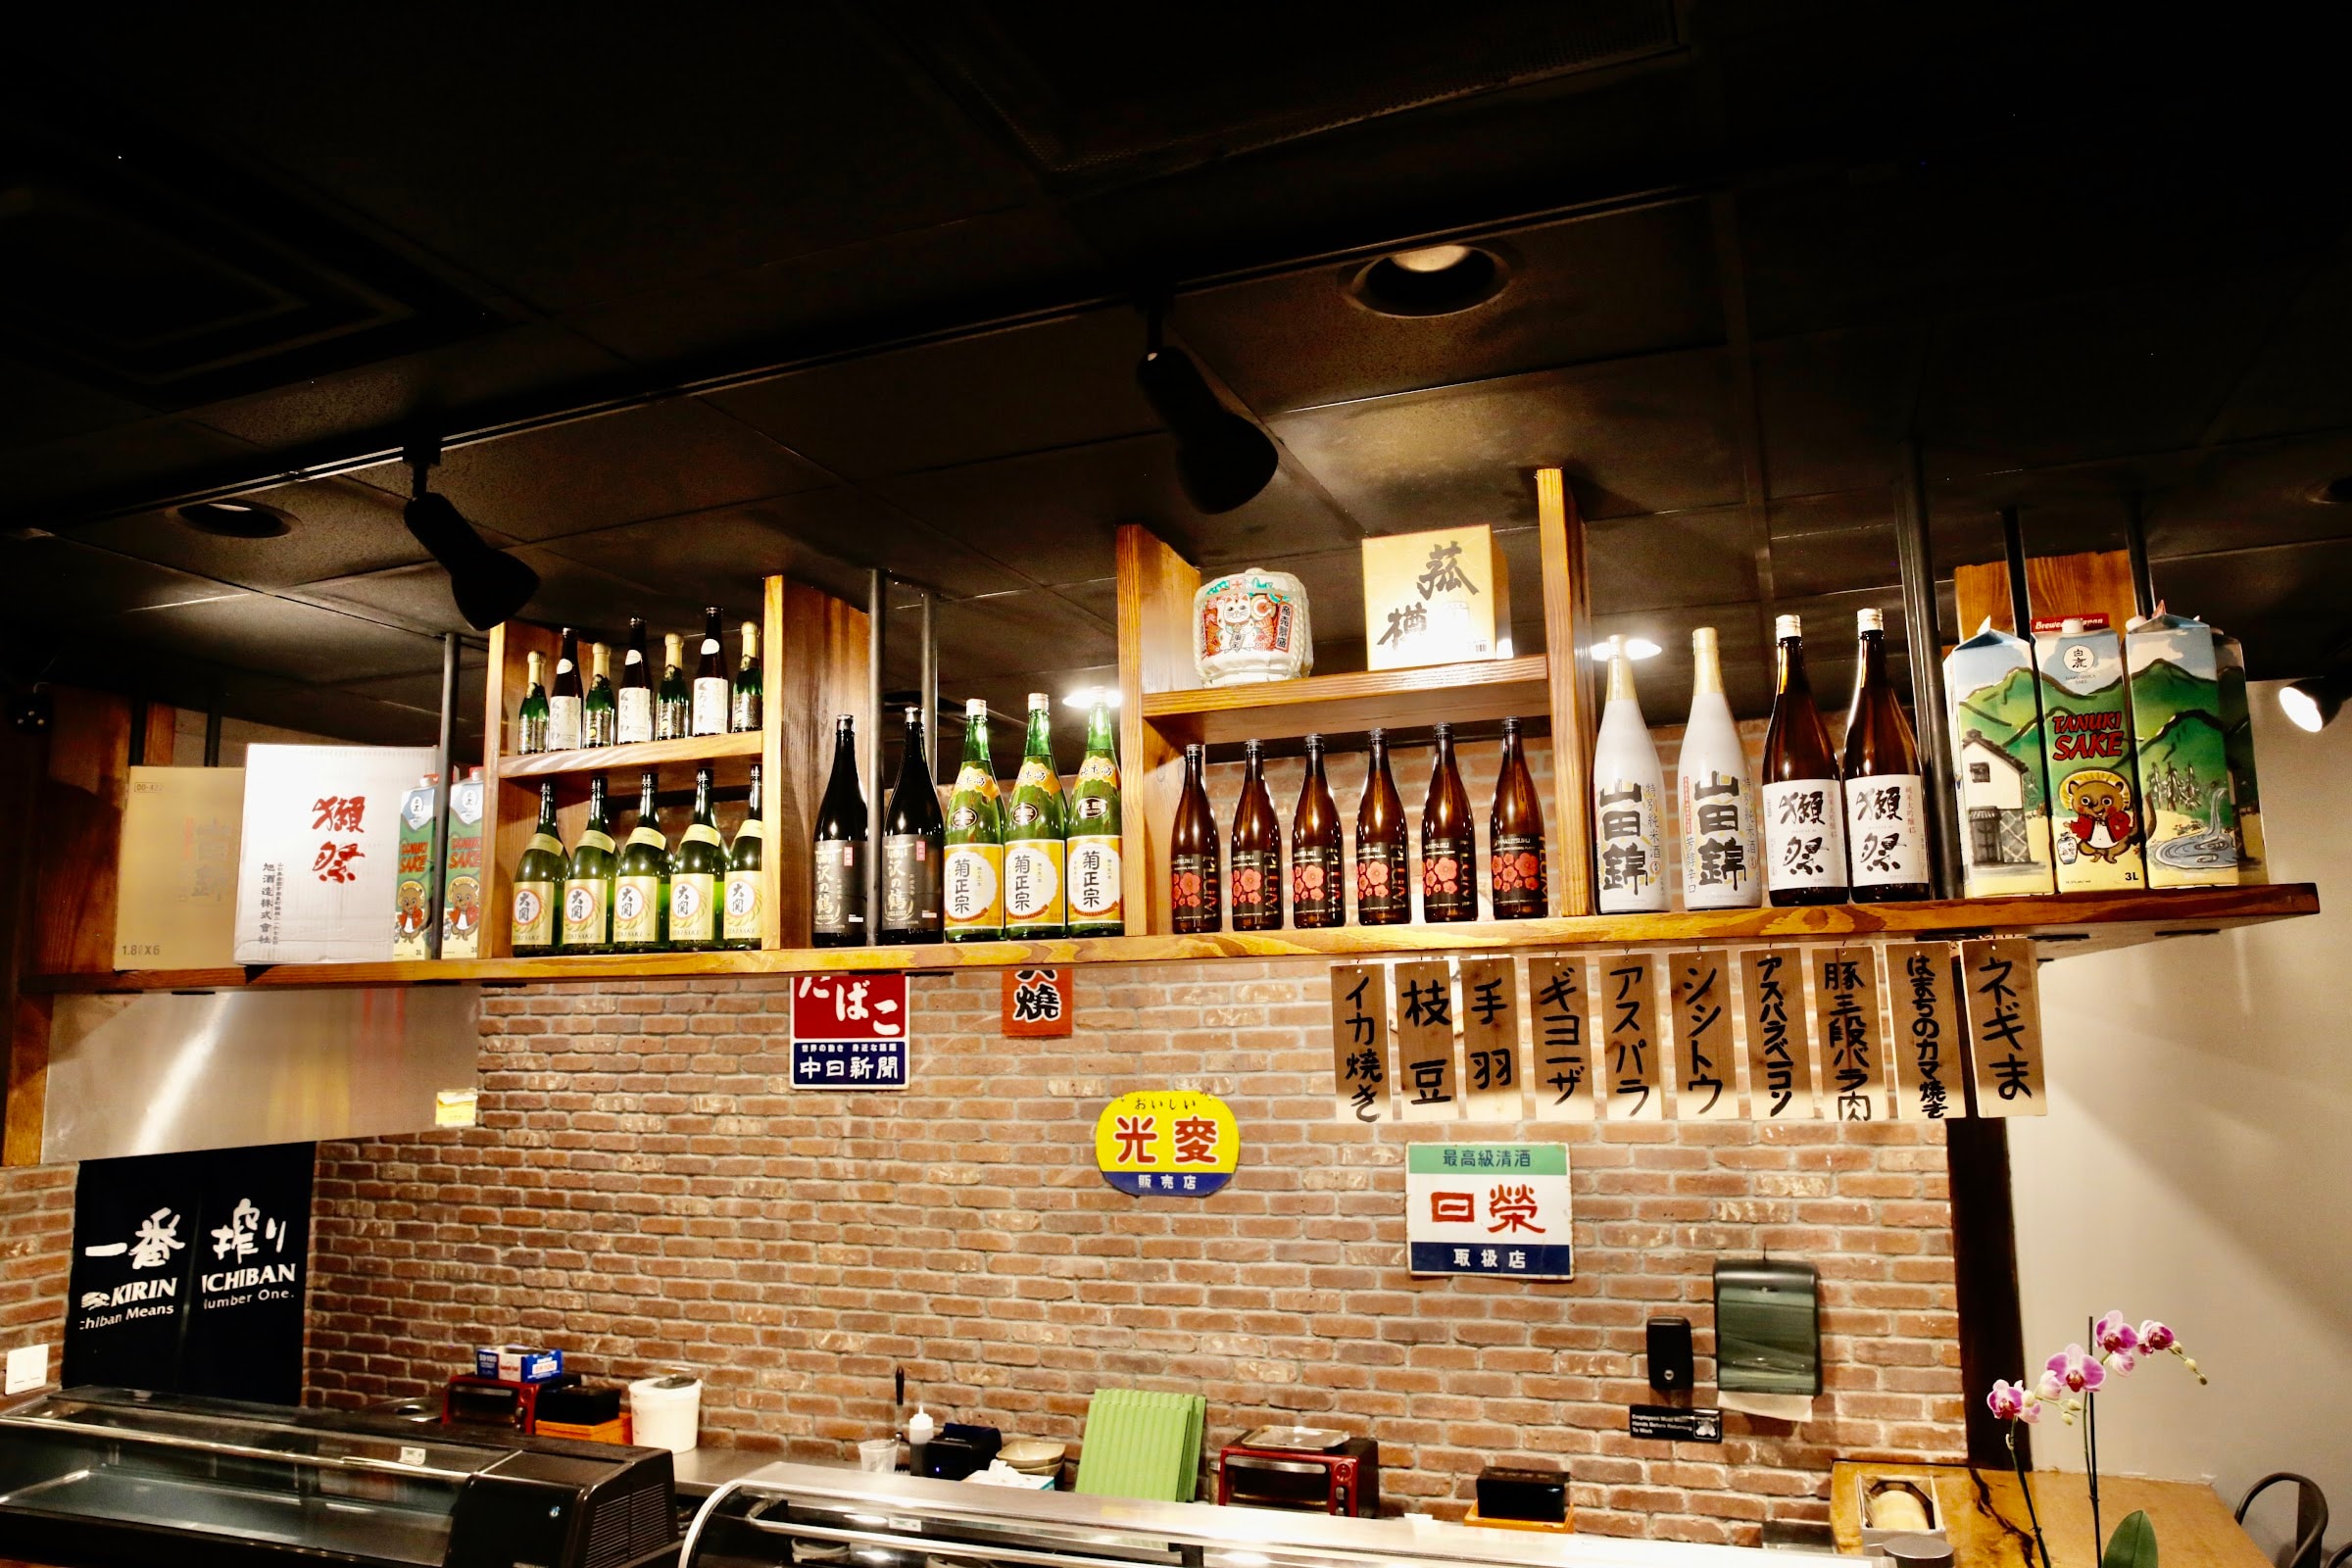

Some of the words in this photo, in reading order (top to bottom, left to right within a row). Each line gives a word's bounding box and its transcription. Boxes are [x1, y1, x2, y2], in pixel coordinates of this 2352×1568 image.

[2034, 620, 2063, 629] Brewe
[2052, 710, 2122, 734] TANUKI
[2053, 731, 2124, 760] SAKE
[312, 795, 366, 884] 獺祭
[1599, 777, 1648, 896] 山田錦
[1694, 770, 1747, 891] 山田錦
[399, 854, 428, 874] SAKE
[955, 858, 970, 914] 菊正宗
[1014, 855, 1030, 911] 菊正宗
[1083, 851, 1100, 908] 菊正宗
[2125, 872, 2138, 881] 3L
[1346, 975, 1383, 1123] イカ焼き
[1400, 979, 1452, 1105] 枝豆
[1469, 976, 1512, 1090] 手羽
[1609, 966, 1649, 1116] アスパラ
[1682, 967, 1724, 1115] シシトウ
[1906, 955, 1949, 1119] はまちのカマ焼き
[1977, 956, 2033, 1102] ネギま
[800, 1055, 899, 1079] 中日新聞
[1135, 1098, 1196, 1110] おいしい
[1138, 1174, 1197, 1191] 販売店
[1443, 1149, 1532, 1168] 最高級清酒
[110, 1277, 177, 1307] KIRIN
[202, 1263, 296, 1294] ICHIBAN
[1453, 1248, 1527, 1269] 取扱店
[125, 1304, 174, 1320] Means
[258, 1289, 294, 1300] One.
